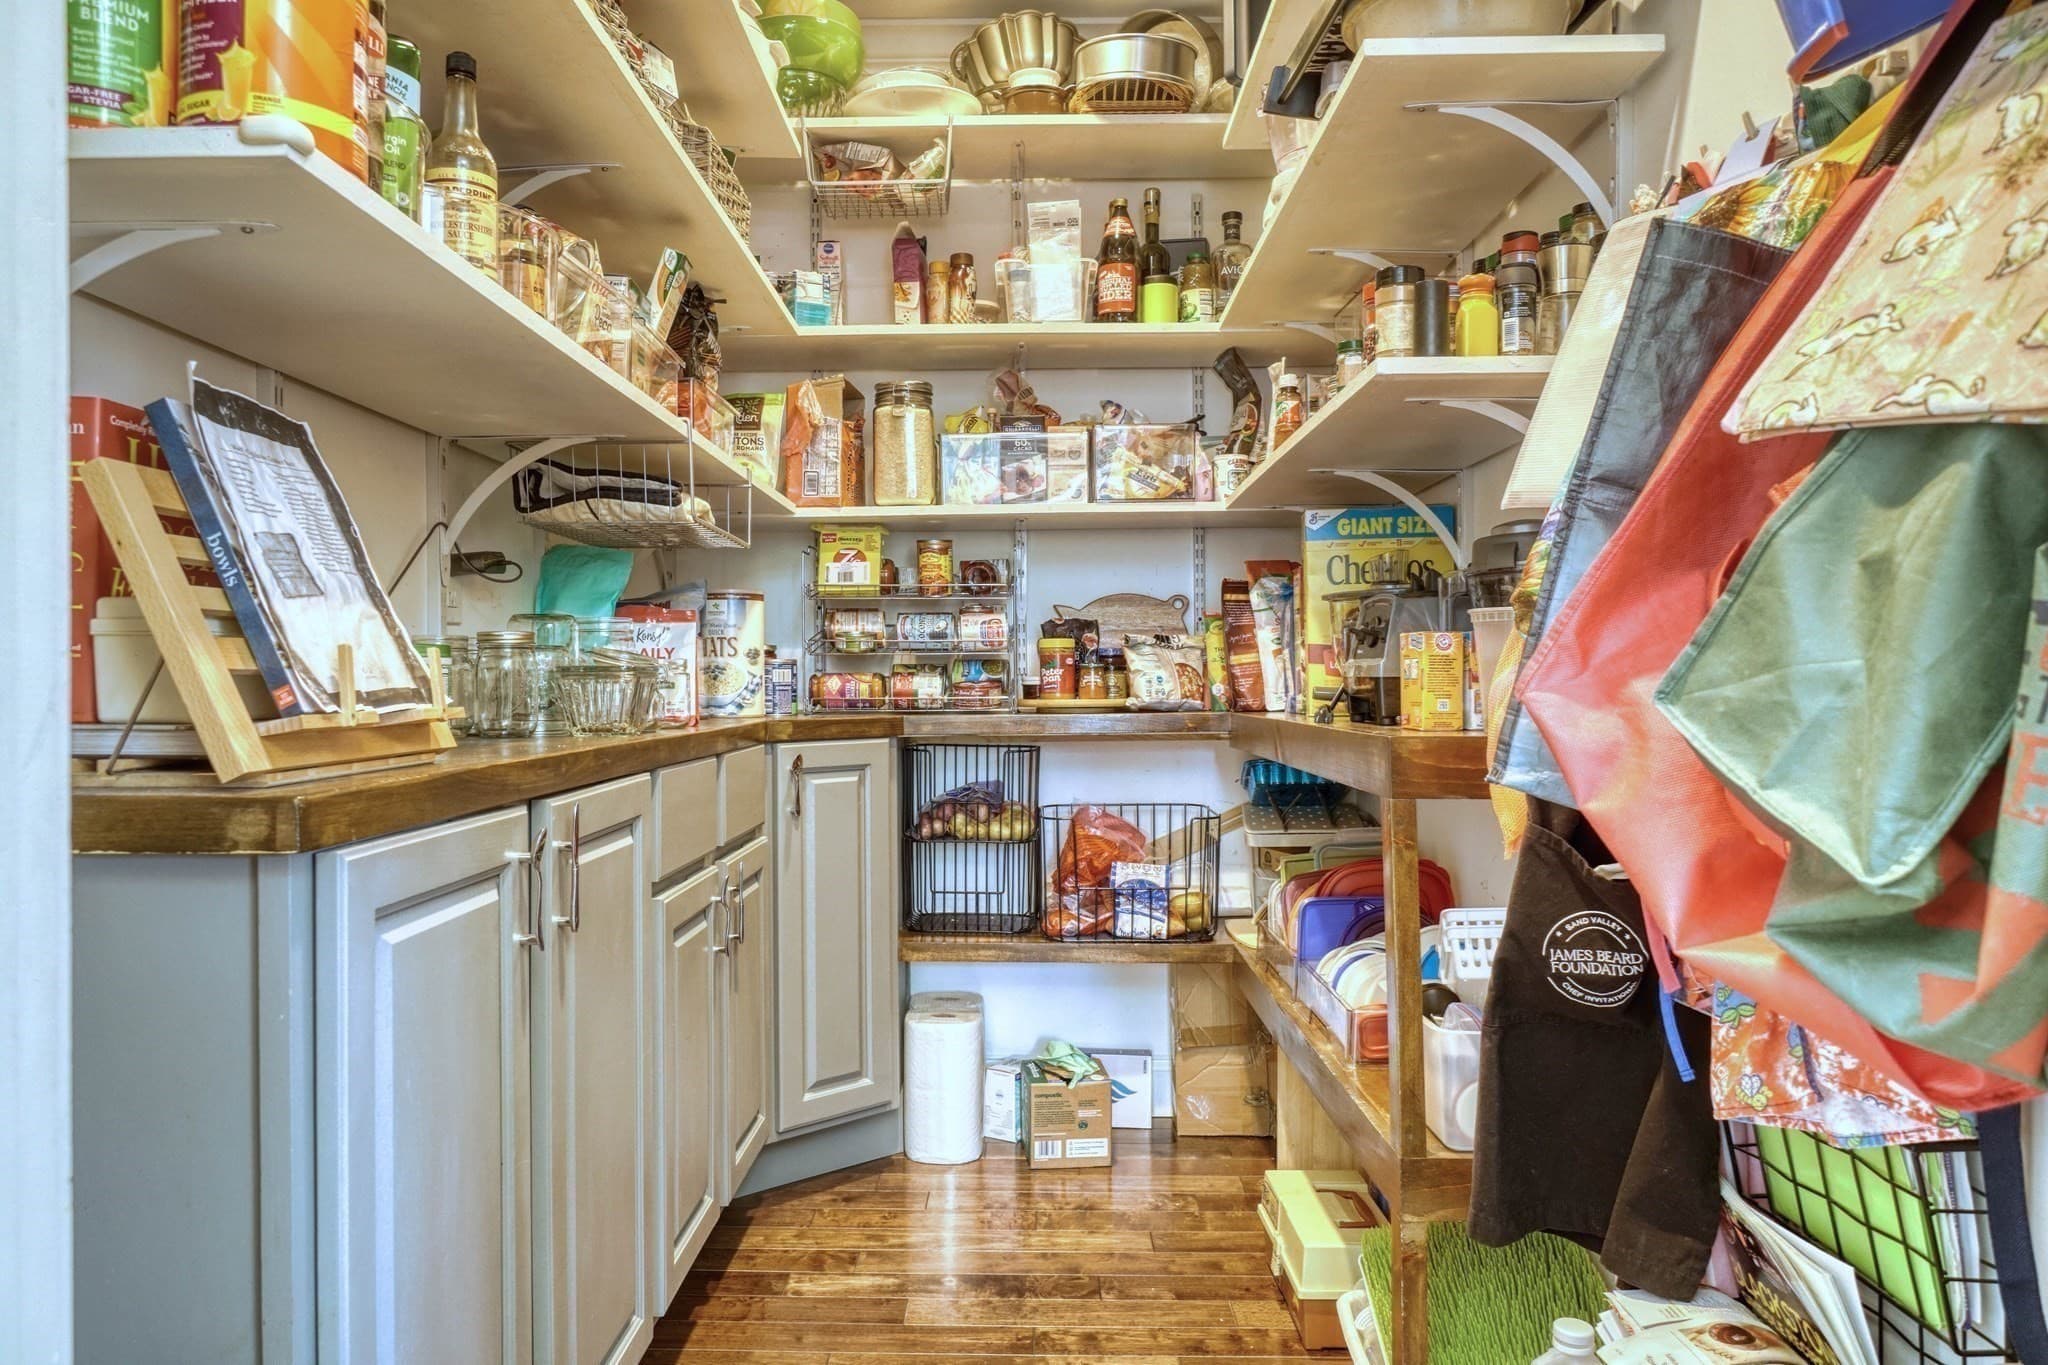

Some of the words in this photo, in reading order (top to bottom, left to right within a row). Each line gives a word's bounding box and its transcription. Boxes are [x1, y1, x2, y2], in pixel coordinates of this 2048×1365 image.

[81, 6, 139, 31] BLEND
[69, 85, 121, 100] GAR-FREE
[83, 96, 122, 109] STEVIA
[386, 134, 407, 148] rgin
[384, 143, 401, 155] Oil
[447, 230, 474, 240] SAUCE
[1221, 264, 1244, 276] AVIO
[1100, 290, 1133, 300] CIDER
[1337, 516, 1393, 536] GIANT
[206, 531, 240, 588] bowls
[1326, 554, 1434, 586] Cheos
[640, 647, 675, 660] AILY
[702, 637, 738, 657] ATS
[1041, 668, 1064, 677] Peter
[1565, 917, 1590, 931] SAND
[1590, 916, 1622, 931] VALLEY
[1550, 949, 1593, 961] JAMES
[1596, 950, 1643, 964] BEARD
[1551, 962, 1644, 976] FOUNDATION
[1562, 982, 1584, 997] CHEF
[1584, 981, 1637, 1003] INVITATIONAL
